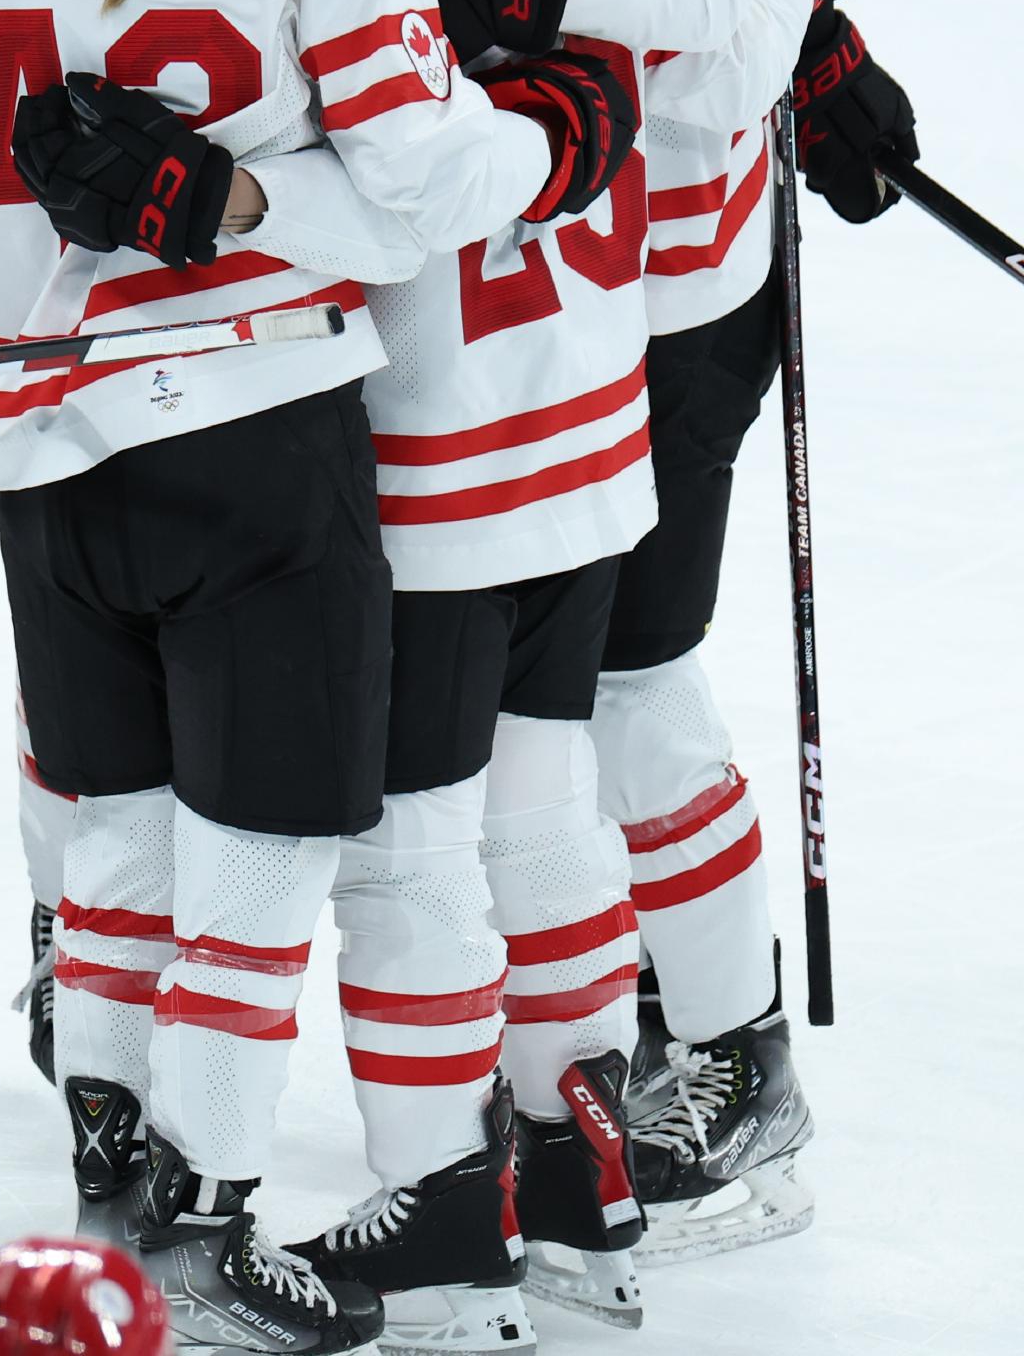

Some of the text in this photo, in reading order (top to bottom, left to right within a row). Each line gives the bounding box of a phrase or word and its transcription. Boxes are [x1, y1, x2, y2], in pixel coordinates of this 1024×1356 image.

[135, 155, 187, 258] CC
[793, 421, 810, 558] TEAM CANADA
[804, 626, 814, 677] AMBROSE
[802, 741, 827, 880] CCM
[572, 1083, 619, 1141] CCM
[721, 1116, 760, 1174] BAUER
[228, 1301, 297, 1345] BAUER
